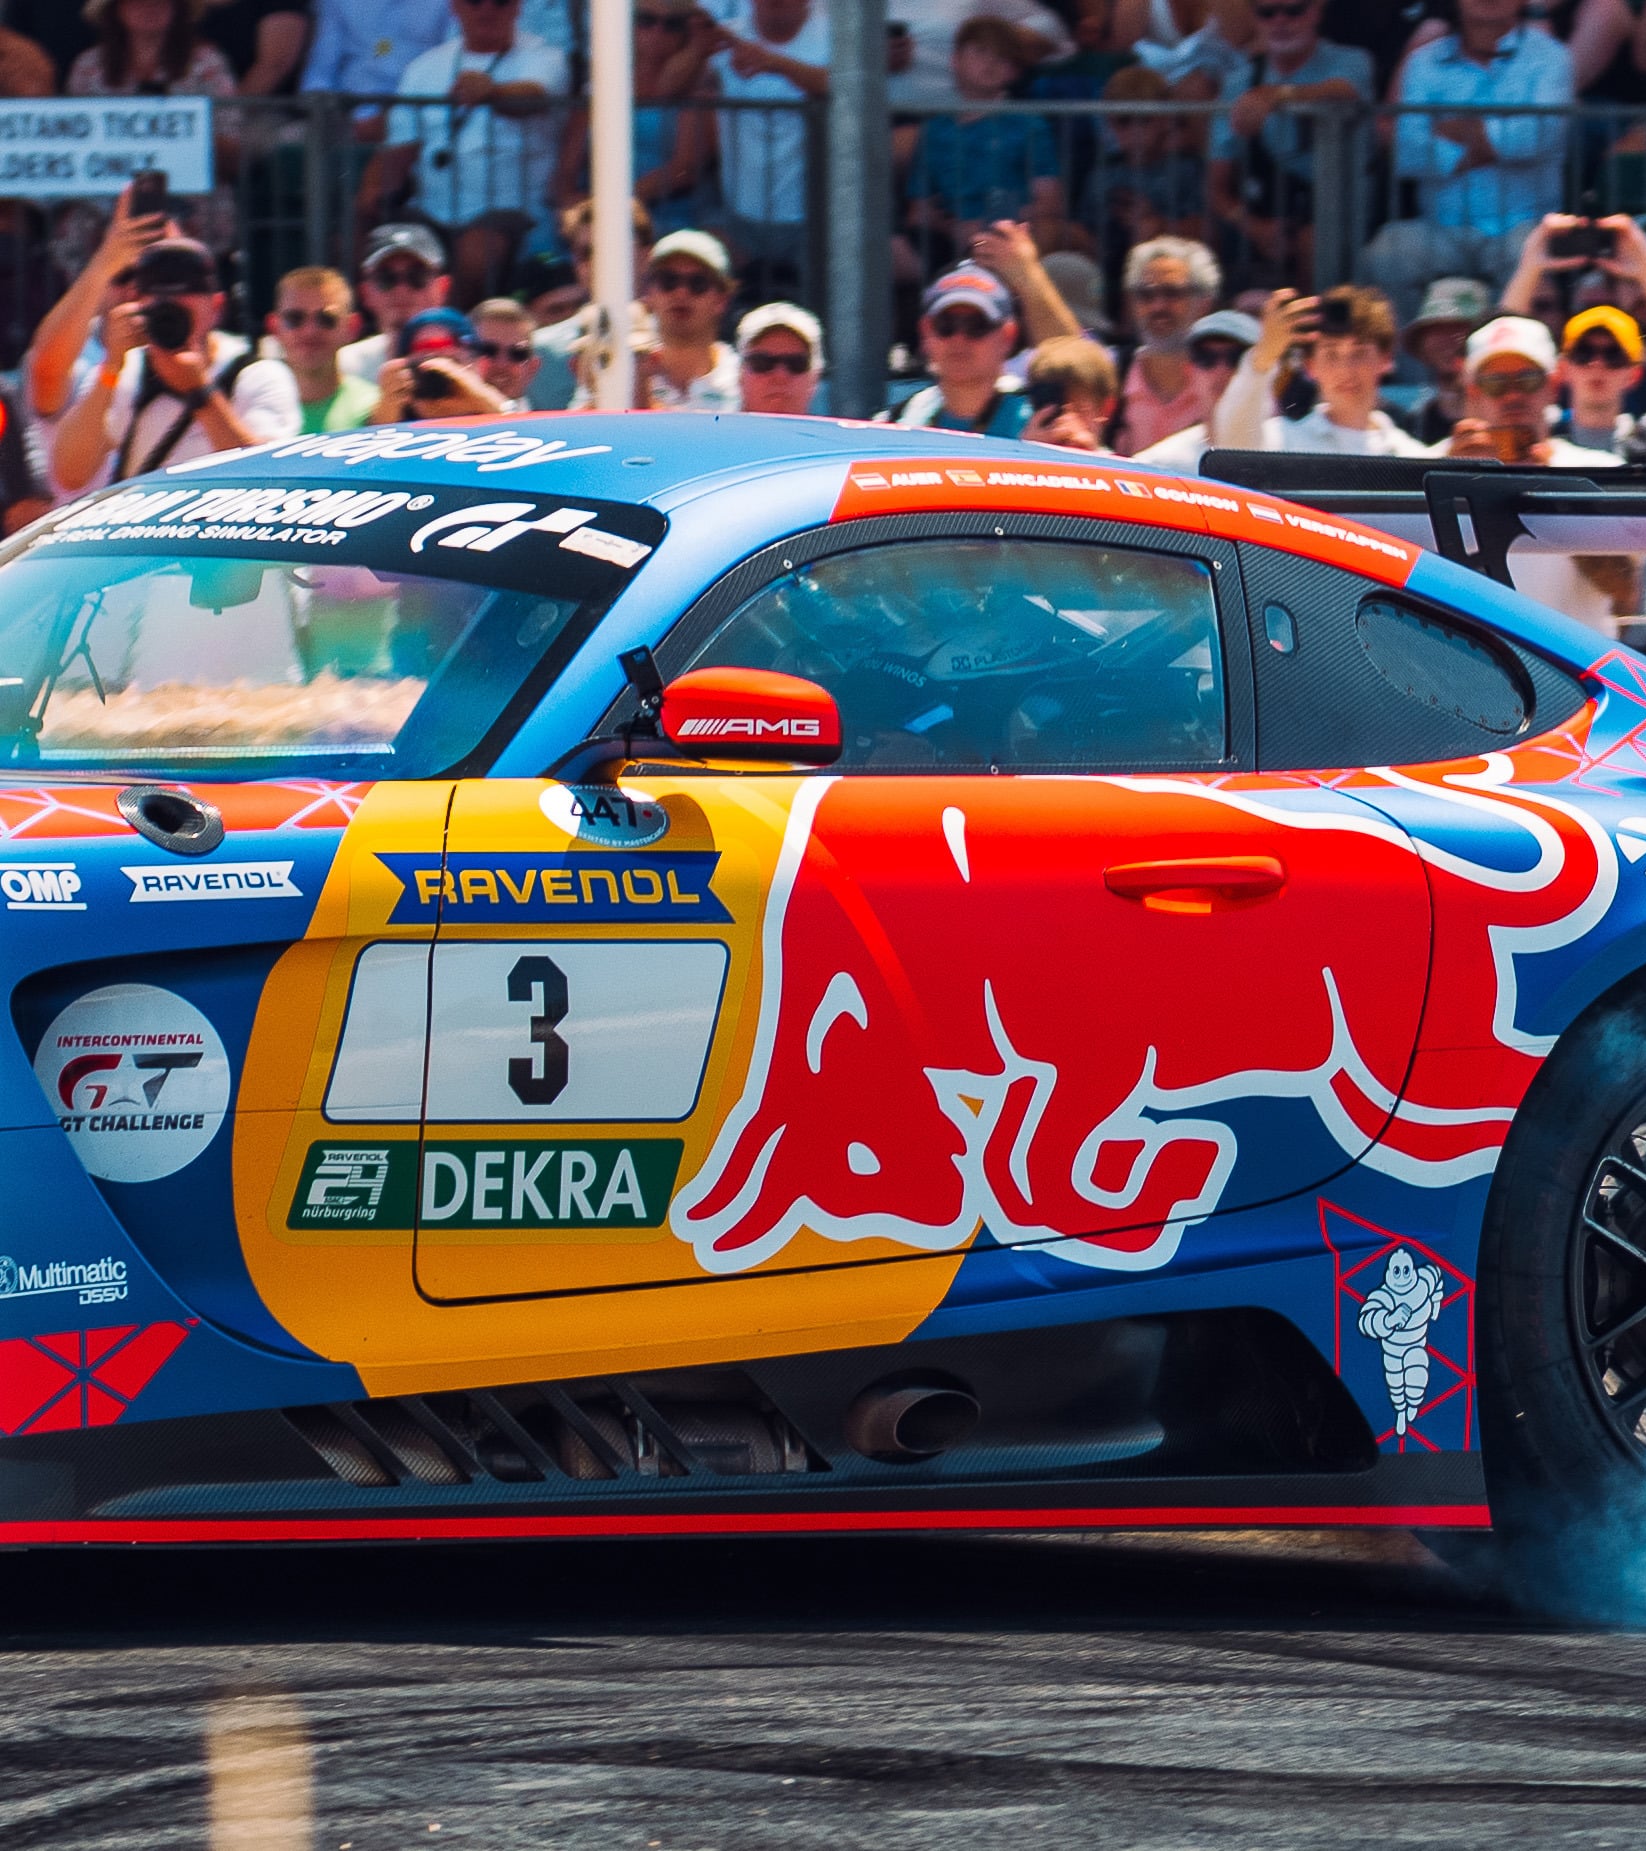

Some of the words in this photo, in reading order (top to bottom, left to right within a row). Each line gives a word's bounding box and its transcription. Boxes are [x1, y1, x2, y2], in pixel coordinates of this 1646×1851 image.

[103, 111, 196, 138] TICKET
[0, 152, 75, 179] DERS
[271, 428, 612, 472] viaplay
[891, 471, 943, 487] AUER
[1285, 513, 1408, 560] VERSTAPPEN
[108, 524, 200, 540] DRIVING
[197, 525, 347, 546] SIMULATOR
[718, 718, 820, 736] AMG
[0, 870, 82, 902] OMP
[143, 871, 285, 893] RAVENOL
[414, 869, 700, 904] RAVENOL
[57, 1033, 204, 1048] INTERCONTINENTAL
[507, 955, 569, 1105] 3
[60, 1116, 86, 1132] GT
[89, 1115, 204, 1132] CHALLENGE
[328, 1153, 384, 1161] RAVENOL
[421, 1147, 647, 1221] DEKRA
[302, 1205, 377, 1221] nürburgring
[19, 1256, 127, 1291] Multimatic
[79, 1286, 128, 1305] DSSV
